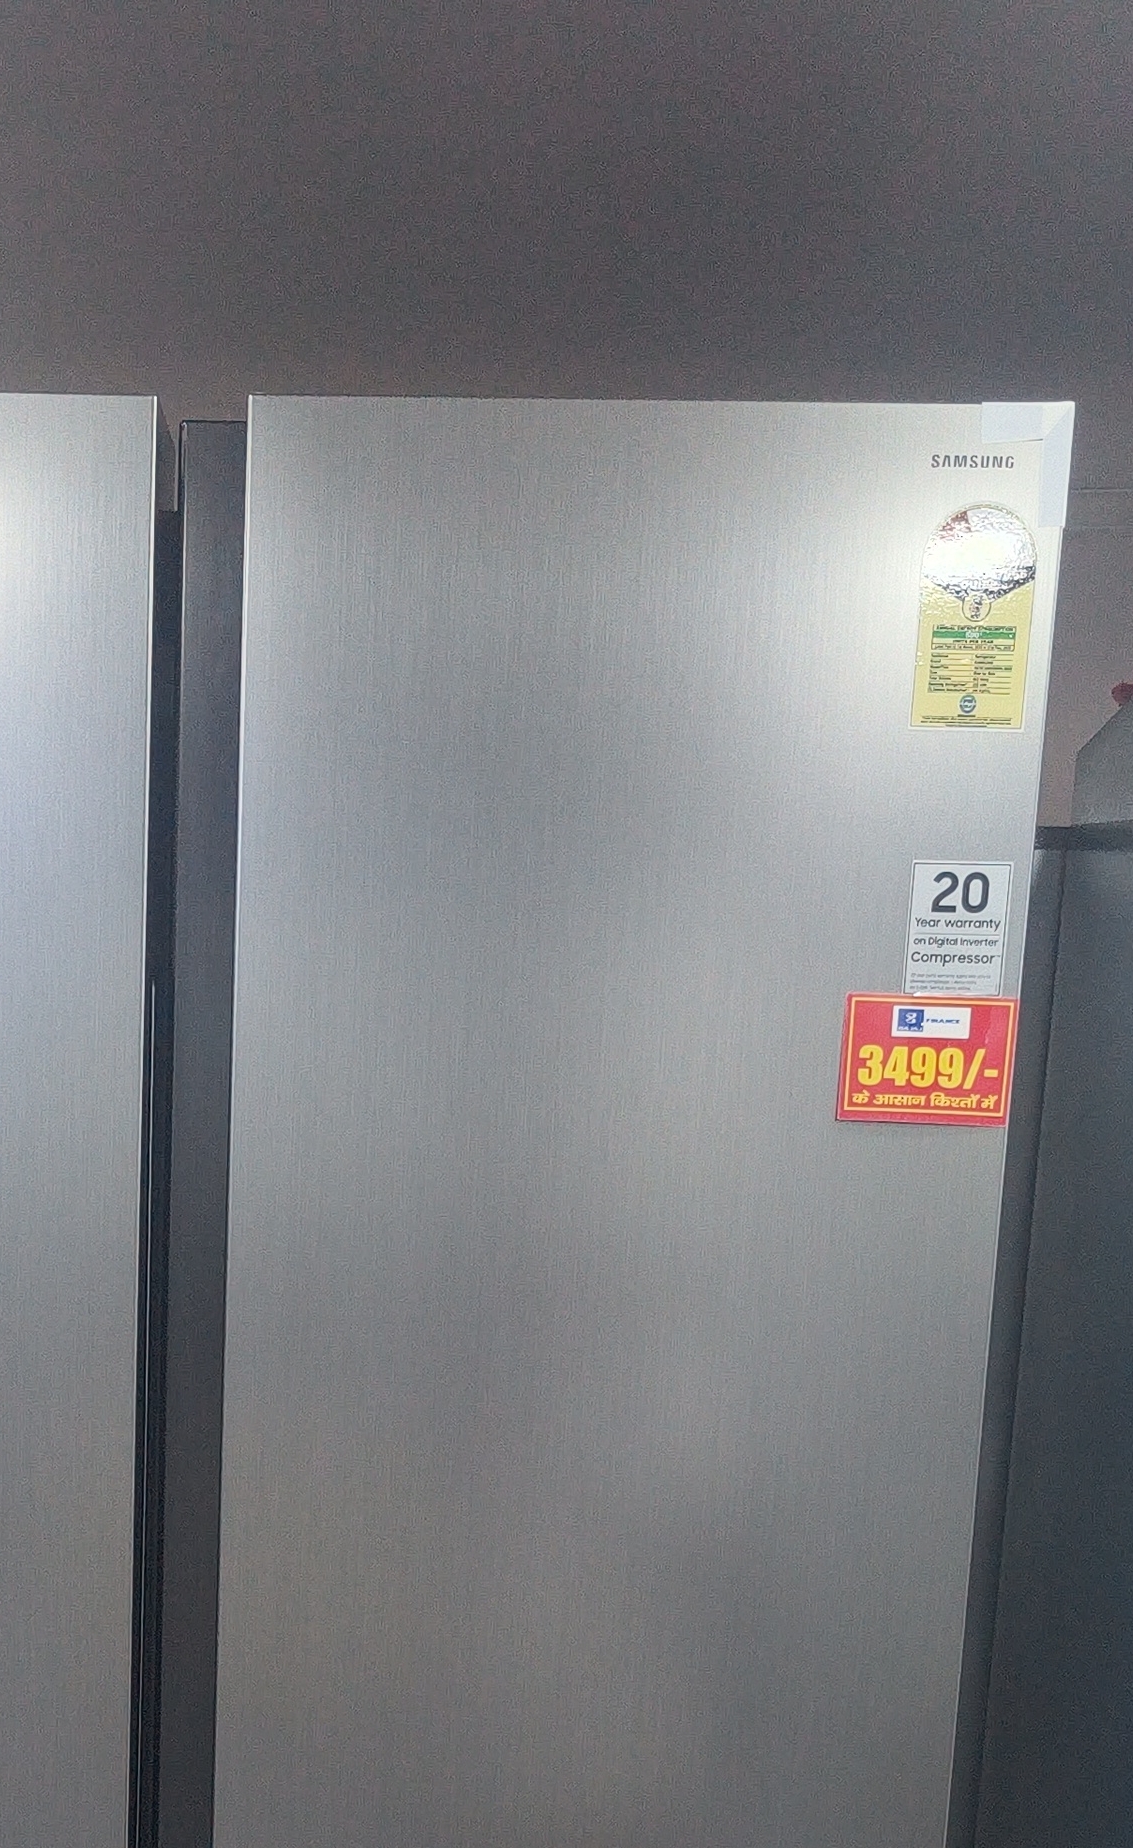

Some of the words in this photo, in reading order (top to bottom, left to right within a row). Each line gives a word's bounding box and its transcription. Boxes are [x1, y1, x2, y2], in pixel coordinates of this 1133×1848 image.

[931, 454, 1015, 469] SAMSUNG
[931, 871, 990, 914] 20
[915, 917, 941, 928] Year
[944, 919, 1001, 933] warranty
[913, 937, 926, 946] on
[928, 936, 958, 948] Digital
[960, 937, 999, 947] Inverter
[857, 1044, 999, 1090] 3499/-
[852, 1090, 870, 1105] के
[873, 1093, 927, 1107] आसान
[981, 1094, 999, 1109] में
